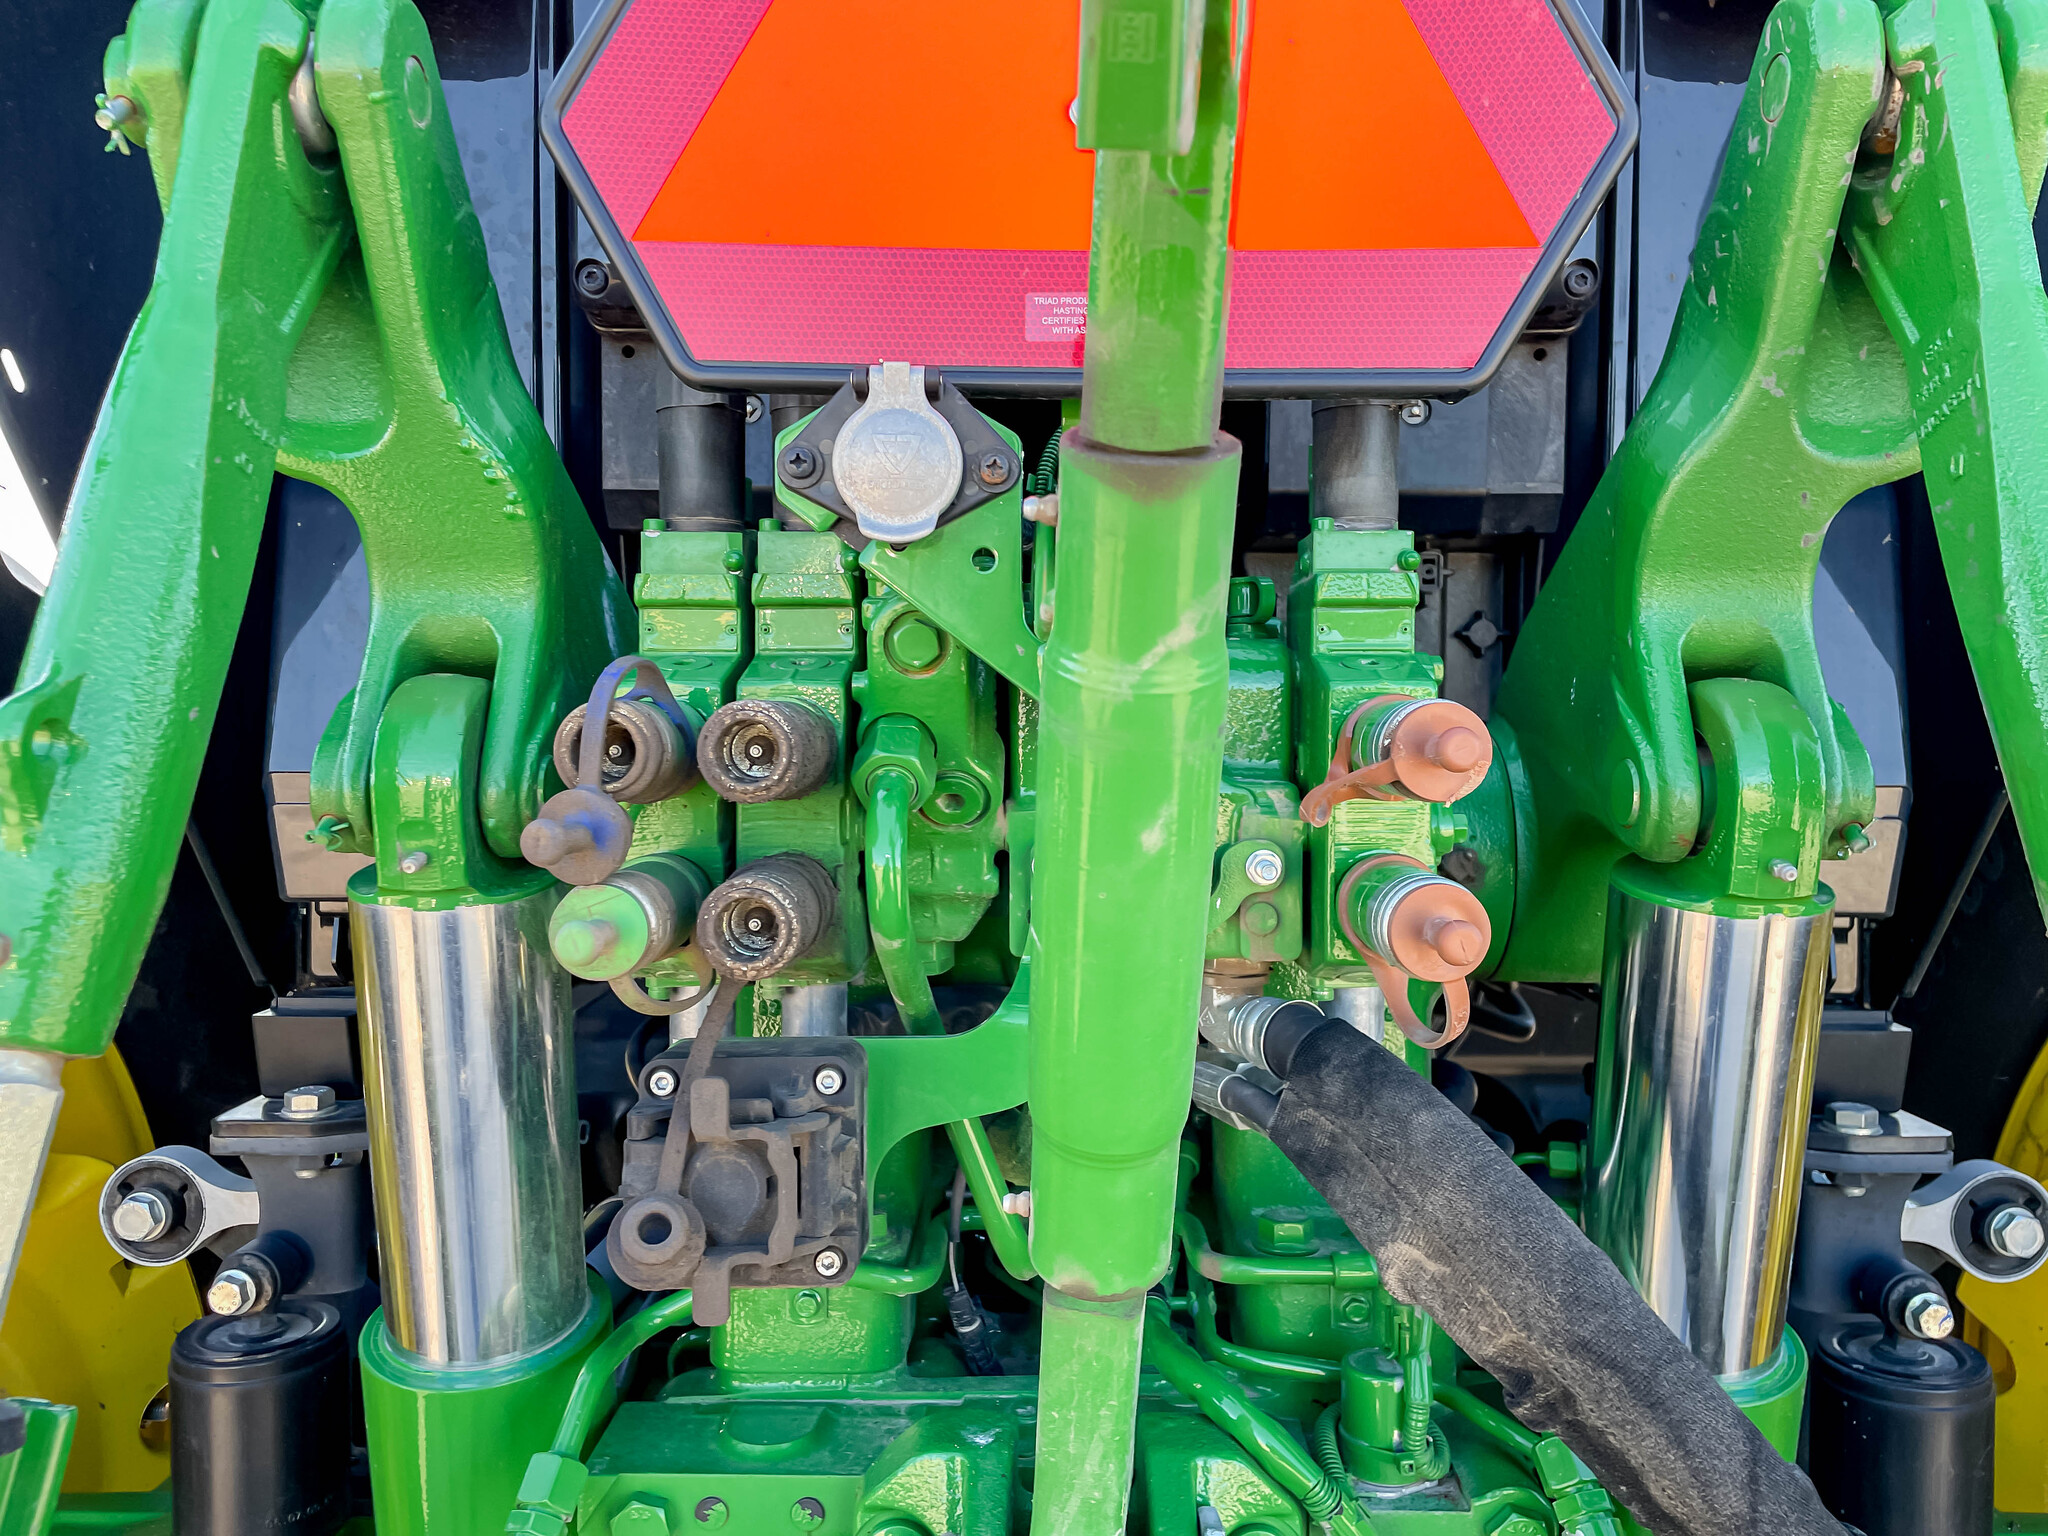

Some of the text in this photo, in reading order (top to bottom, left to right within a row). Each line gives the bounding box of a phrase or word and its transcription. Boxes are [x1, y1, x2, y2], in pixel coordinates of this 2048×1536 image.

[1034, 297, 1059, 305] TRIAD
[1041, 316, 1085, 325] CERTIFIES
[1052, 326, 1074, 335] WITH
